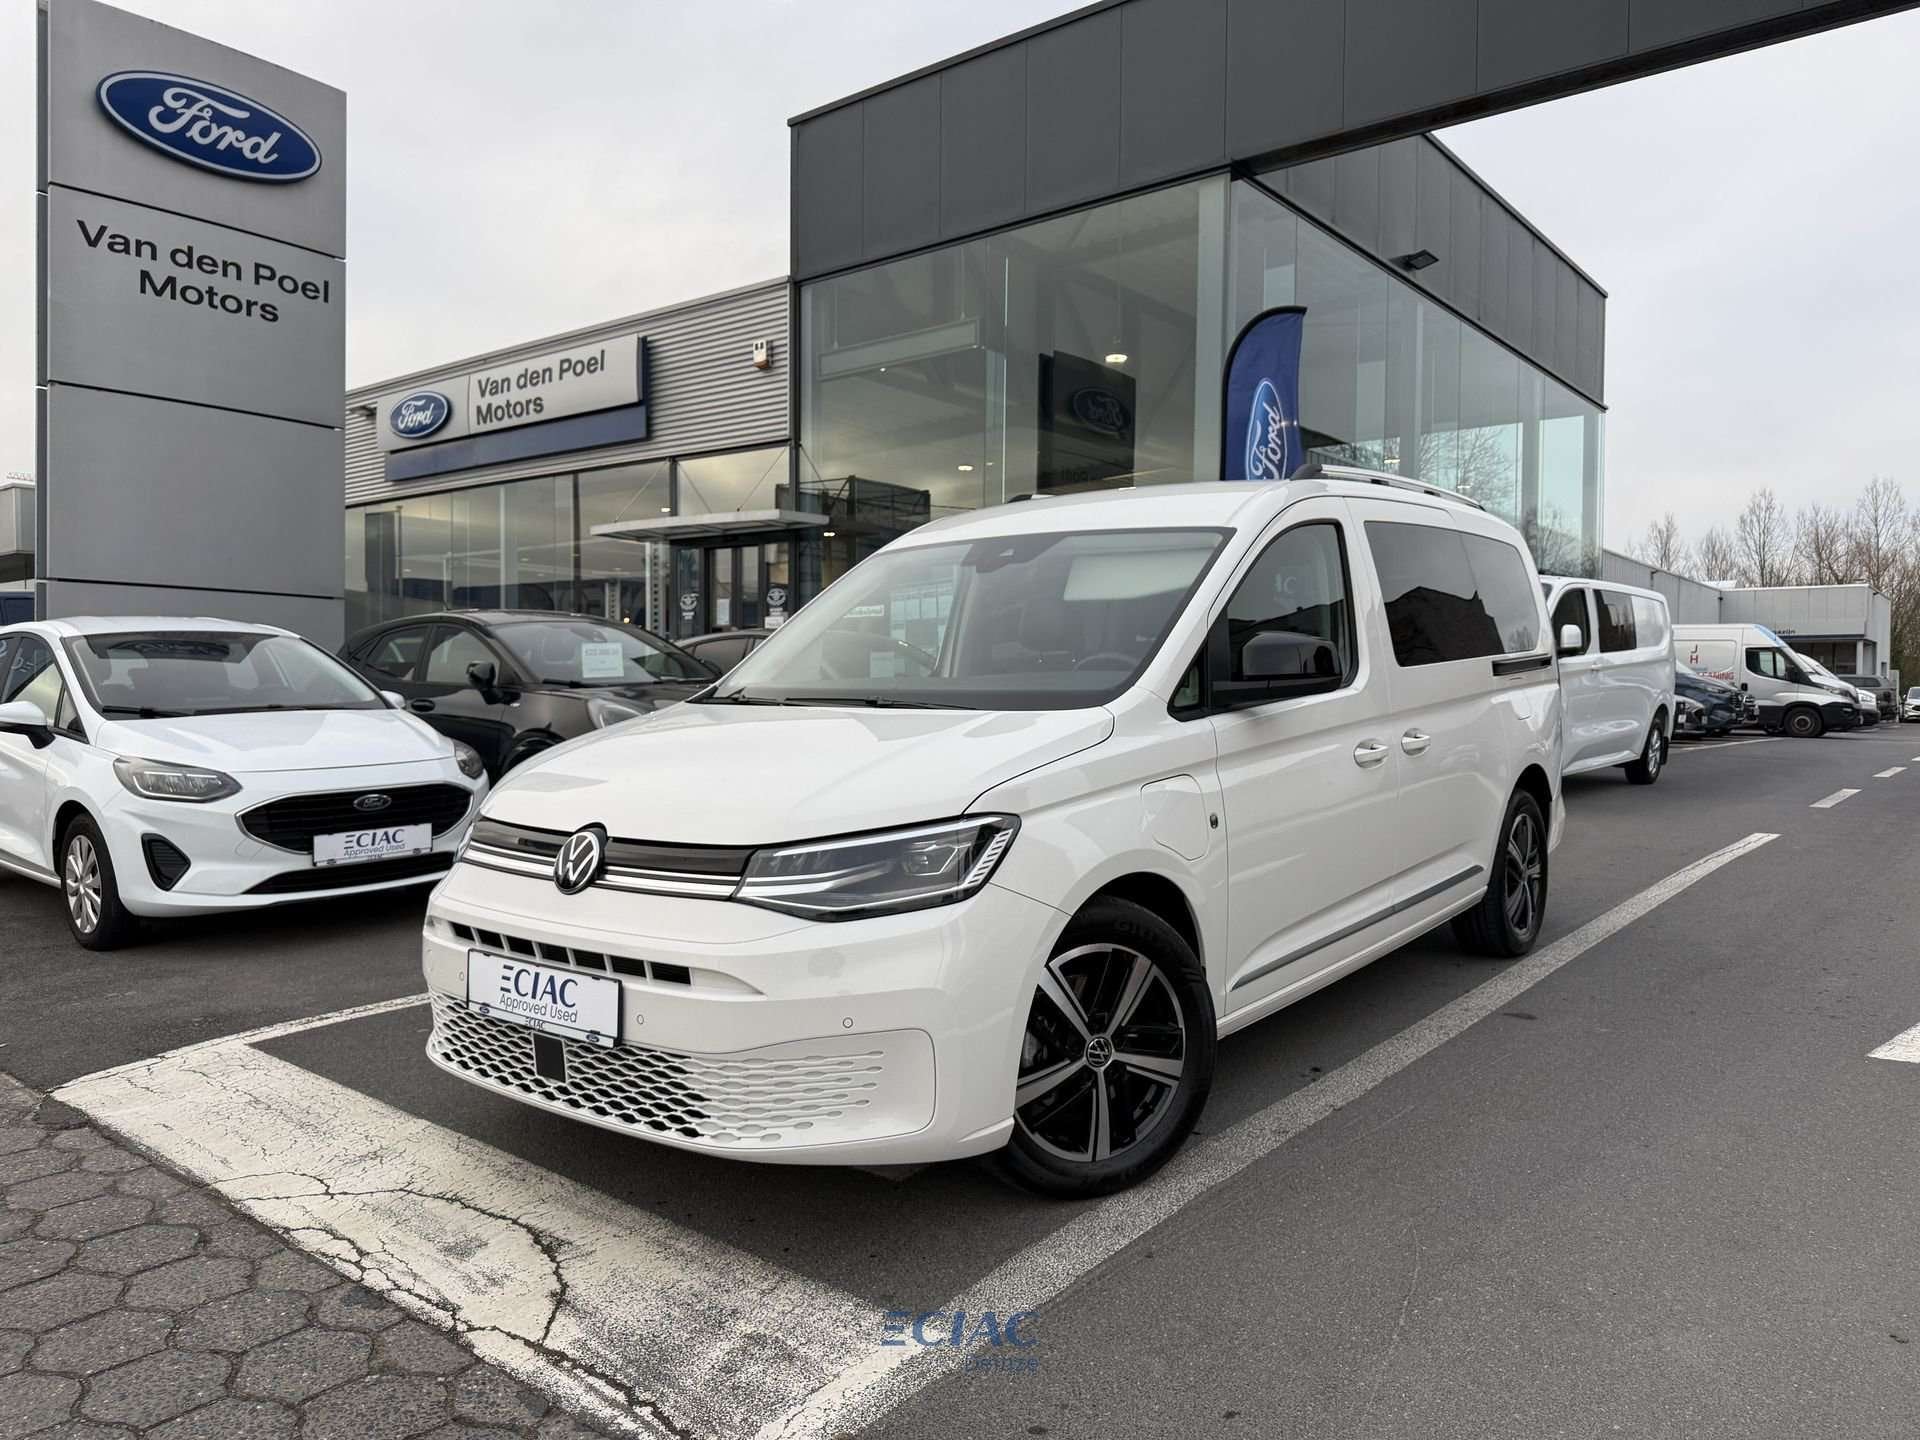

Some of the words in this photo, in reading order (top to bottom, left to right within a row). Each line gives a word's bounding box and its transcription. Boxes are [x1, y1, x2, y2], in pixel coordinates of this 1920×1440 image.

[149, 87, 279, 164] Ford
[76, 219, 158, 261] Van
[170, 245, 243, 281] den
[253, 262, 330, 304] Poel
[139, 269, 279, 323] Motors
[478, 377, 511, 399] Van
[516, 368, 553, 390] den
[559, 349, 605, 381] Poel
[398, 399, 435, 429] Ford
[476, 397, 544, 426] Motors
[1250, 401, 1282, 480] Ford
[344, 828, 404, 850] ECIAC
[344, 845, 384, 858] Approved
[499, 993, 547, 1016] Approved
[550, 1004, 578, 1023] Used
[500, 964, 578, 1008] ECIAC
